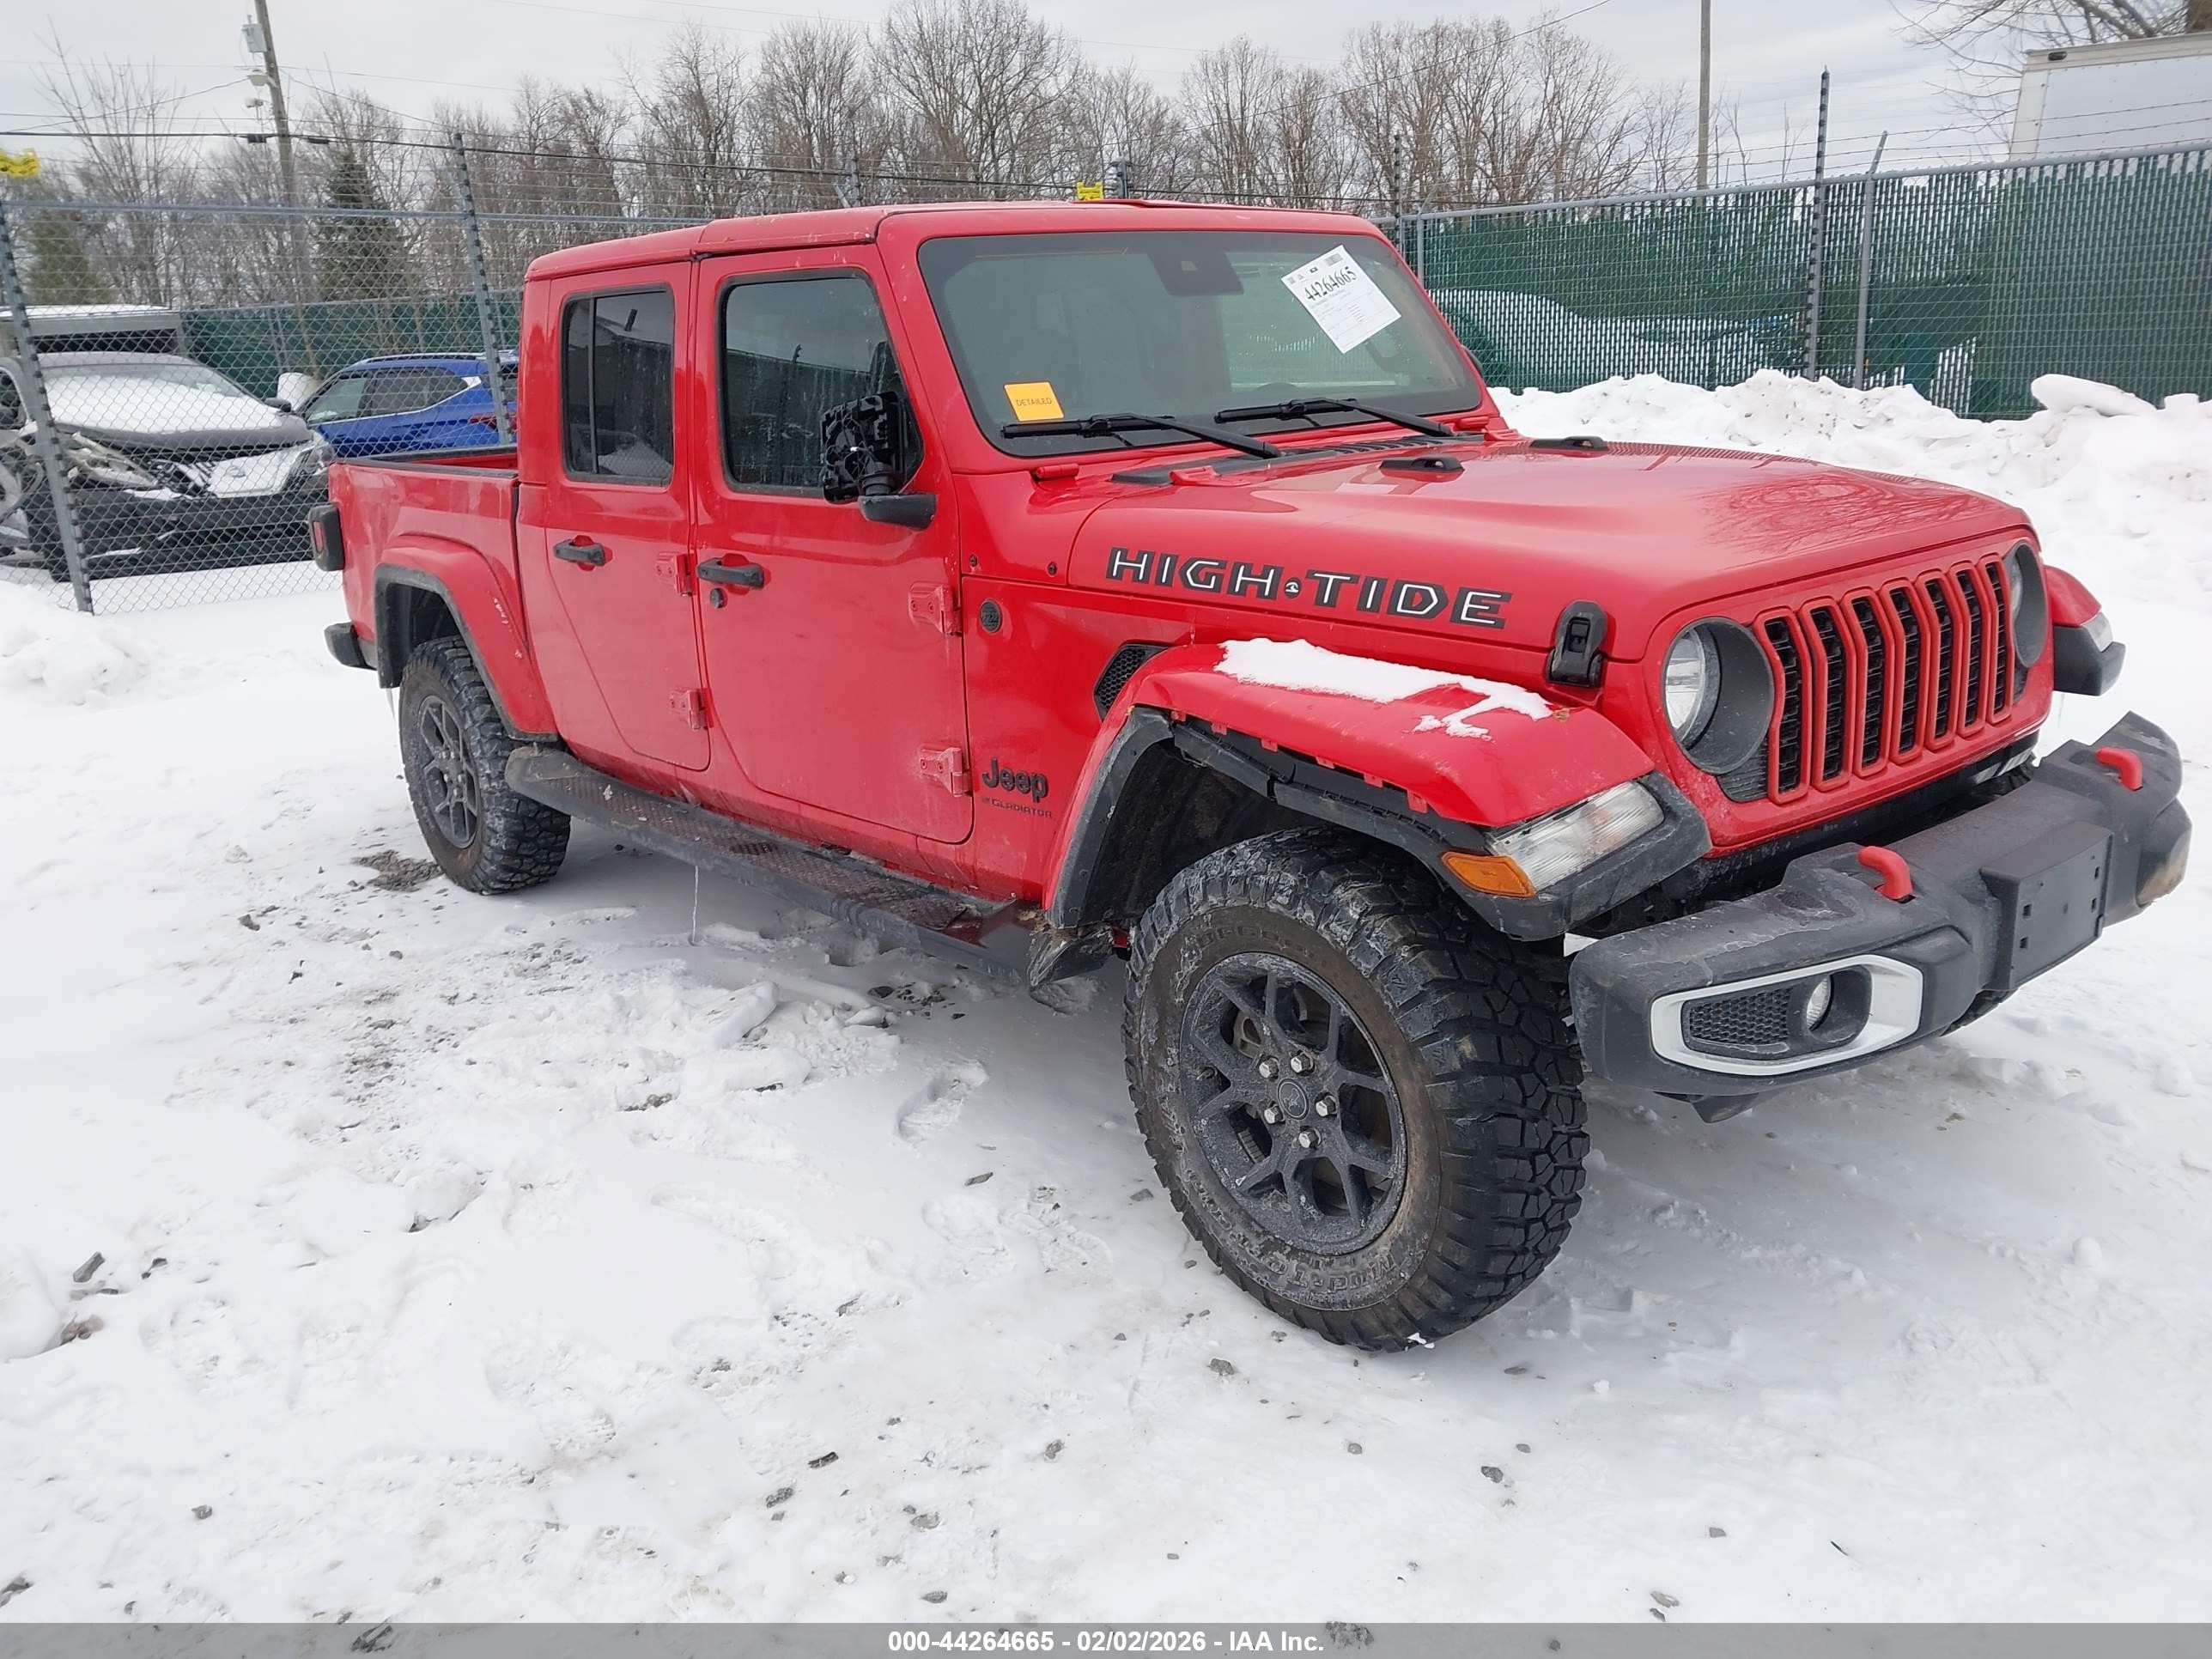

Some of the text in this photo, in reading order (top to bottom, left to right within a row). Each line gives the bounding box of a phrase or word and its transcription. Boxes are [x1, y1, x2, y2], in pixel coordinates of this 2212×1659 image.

[1304, 265, 1358, 302] 44264665
[1106, 547, 1513, 629] HIGH TIDE
[981, 758, 1048, 803] Jeep
[992, 798, 1054, 818] GLADIATOR
